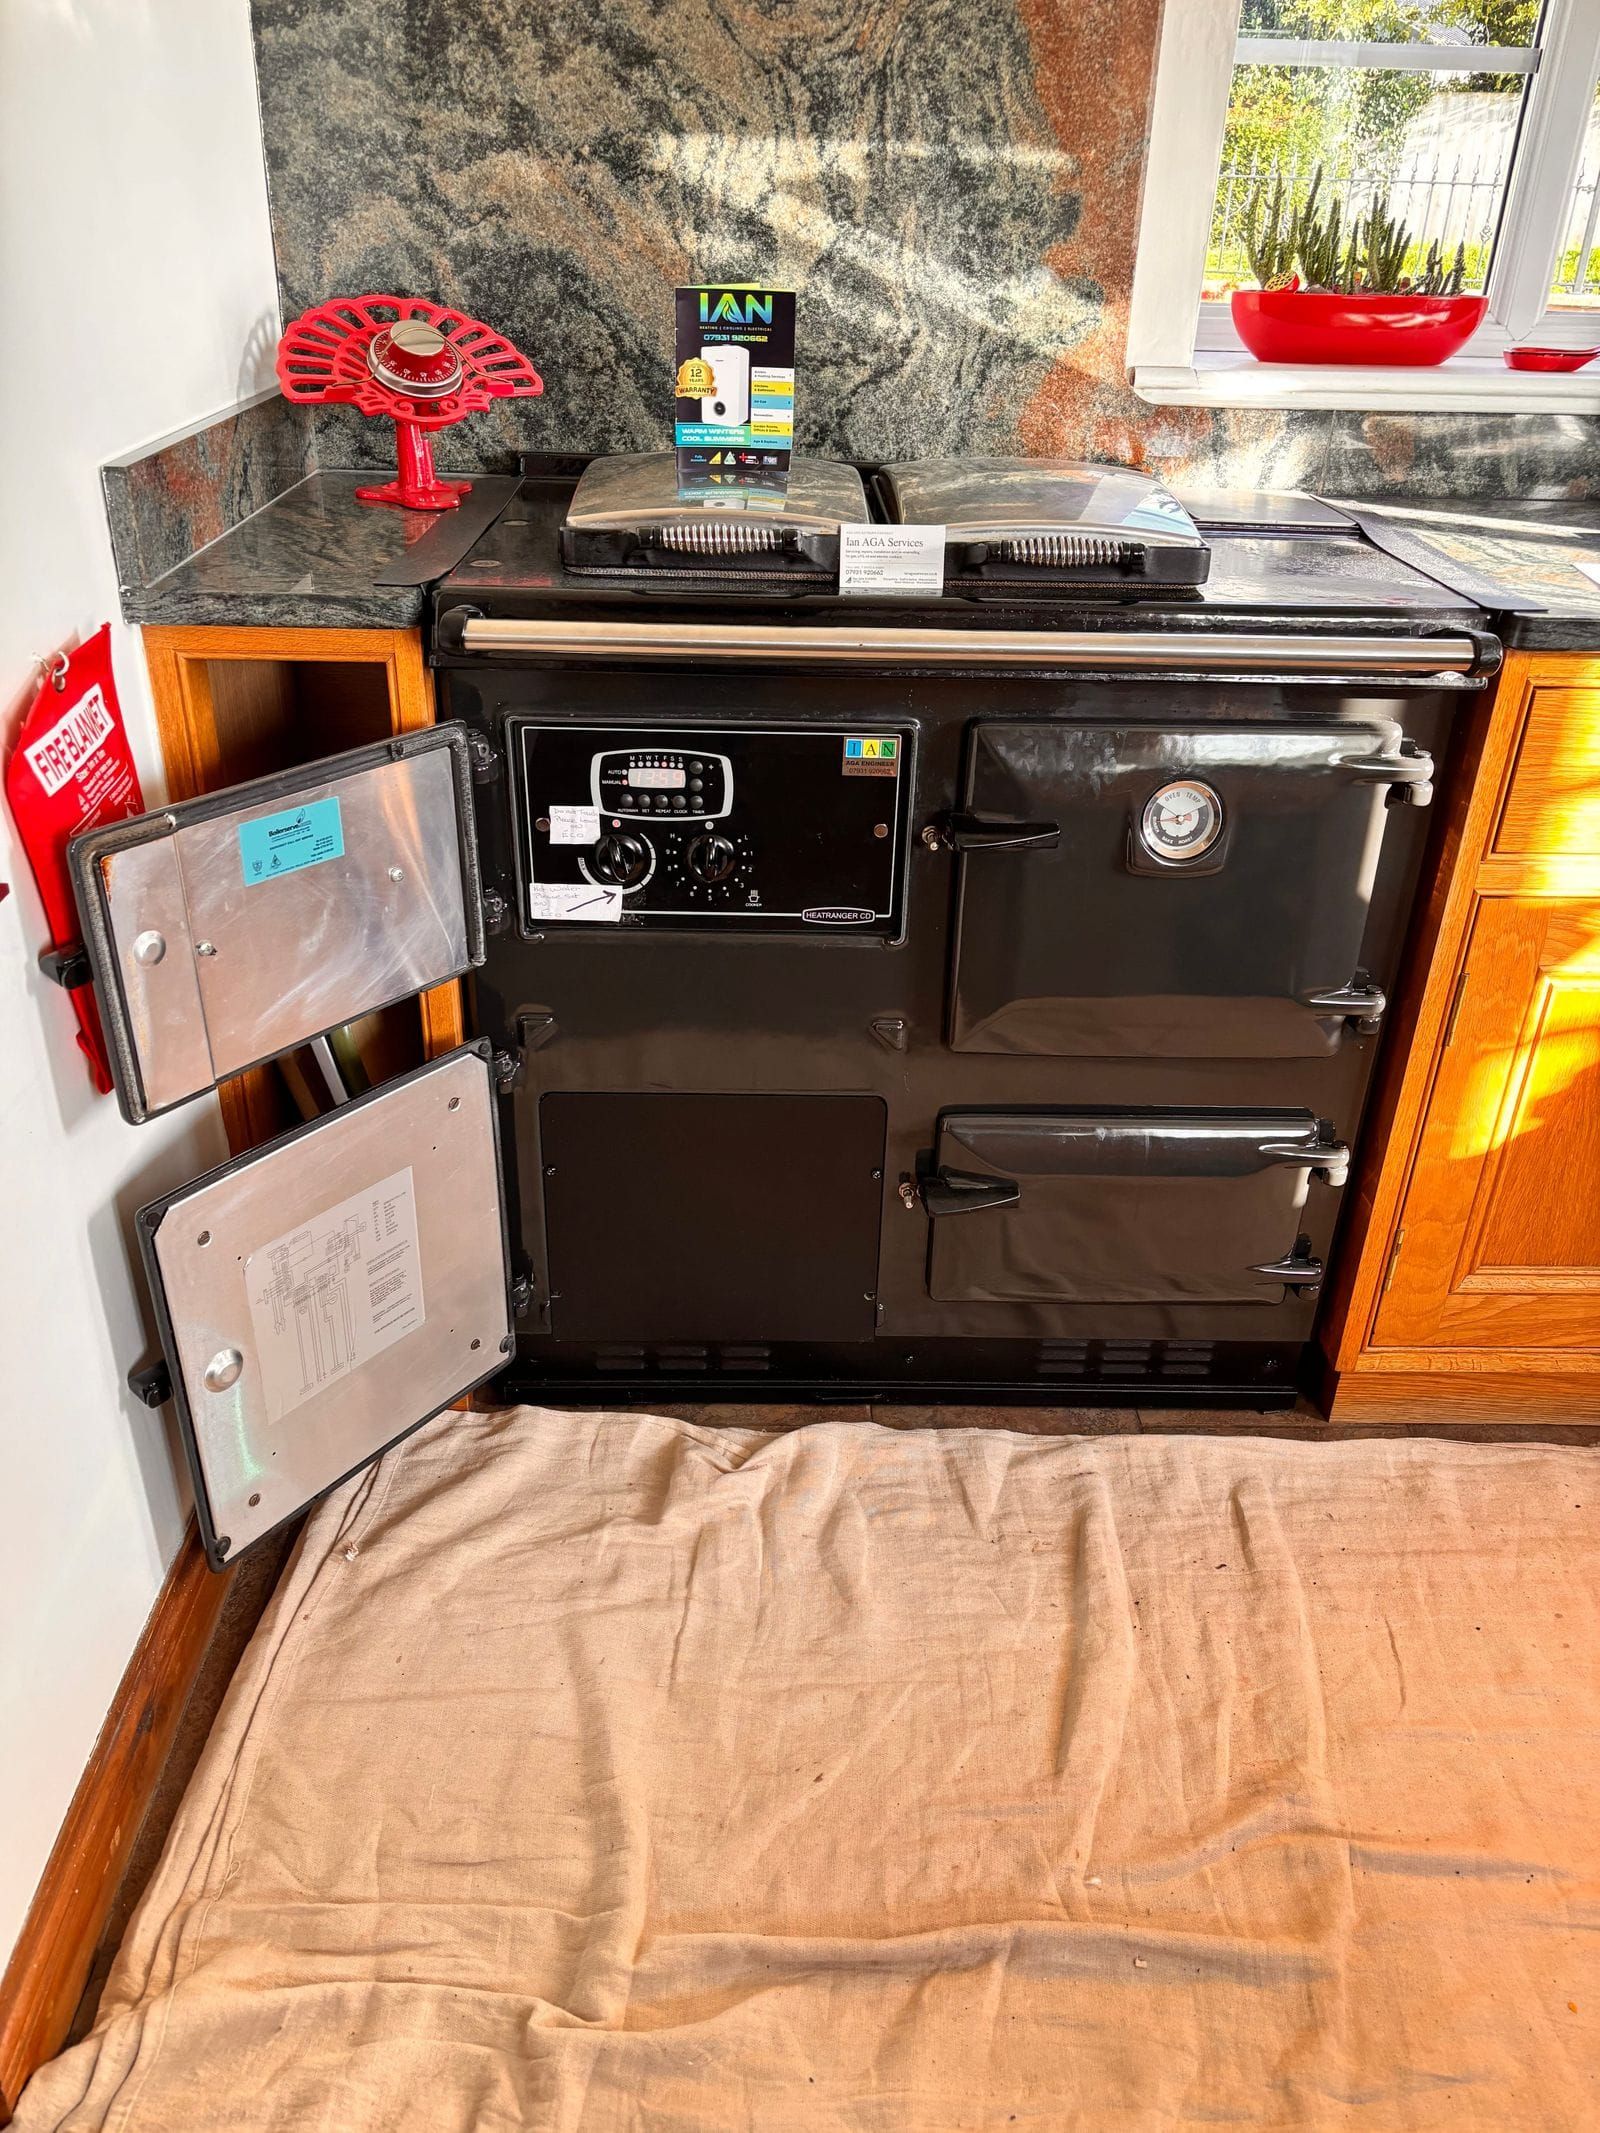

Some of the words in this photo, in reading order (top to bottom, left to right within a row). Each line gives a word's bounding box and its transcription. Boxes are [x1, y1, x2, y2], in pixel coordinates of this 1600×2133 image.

[700, 292, 772, 324] IAN
[690, 368, 702, 378] 12
[678, 386, 714, 394] WARRANTY
[846, 537, 860, 546] Ian
[862, 538, 885, 546] AGA
[888, 538, 924, 547] Services
[34, 736, 72, 788] FIRE
[1164, 791, 1181, 802] OVEN
[1186, 792, 1201, 803] TEMP
[806, 911, 859, 920] HEATRANGER
[860, 912, 871, 920] CD
